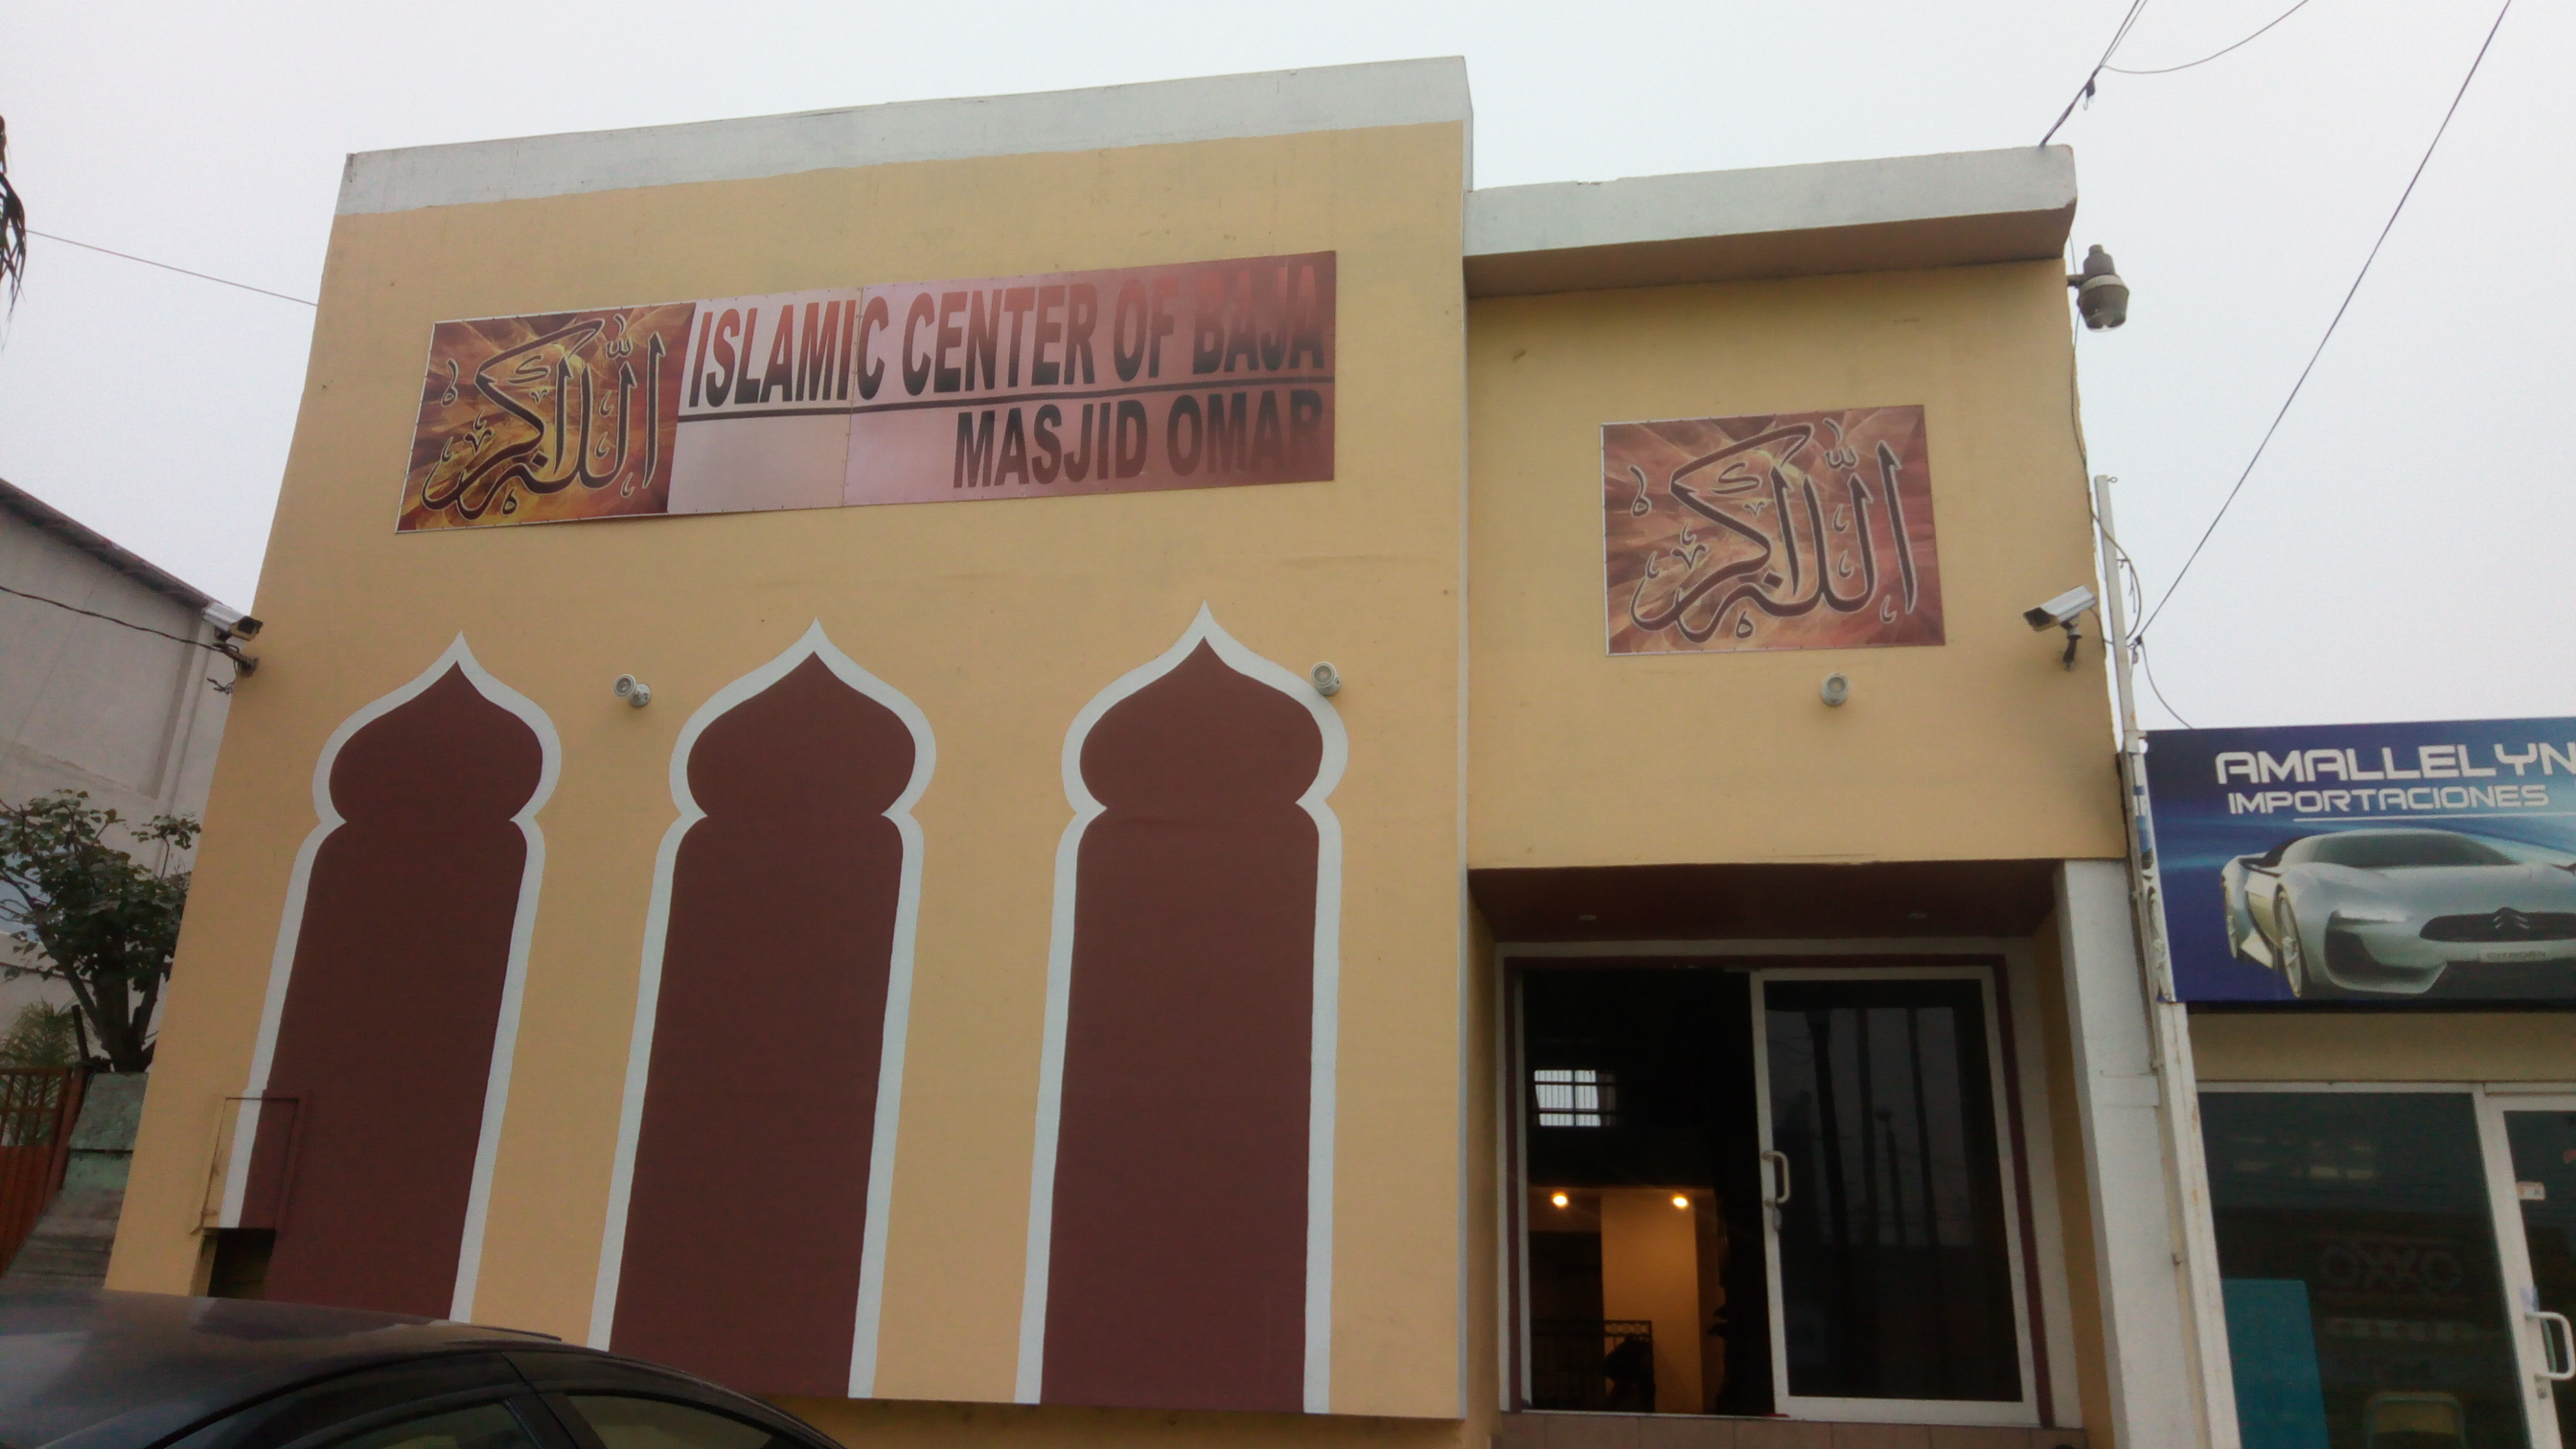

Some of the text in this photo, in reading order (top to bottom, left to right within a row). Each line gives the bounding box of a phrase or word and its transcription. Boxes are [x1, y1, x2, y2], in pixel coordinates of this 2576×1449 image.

[689, 265, 1324, 408] ISLAMIC CENTER OF BAJA
[953, 389, 1324, 488] MASJID OMAR
[2215, 742, 2576, 784] AMALLELYN
[2228, 784, 2549, 814] IMPORTACIONES
